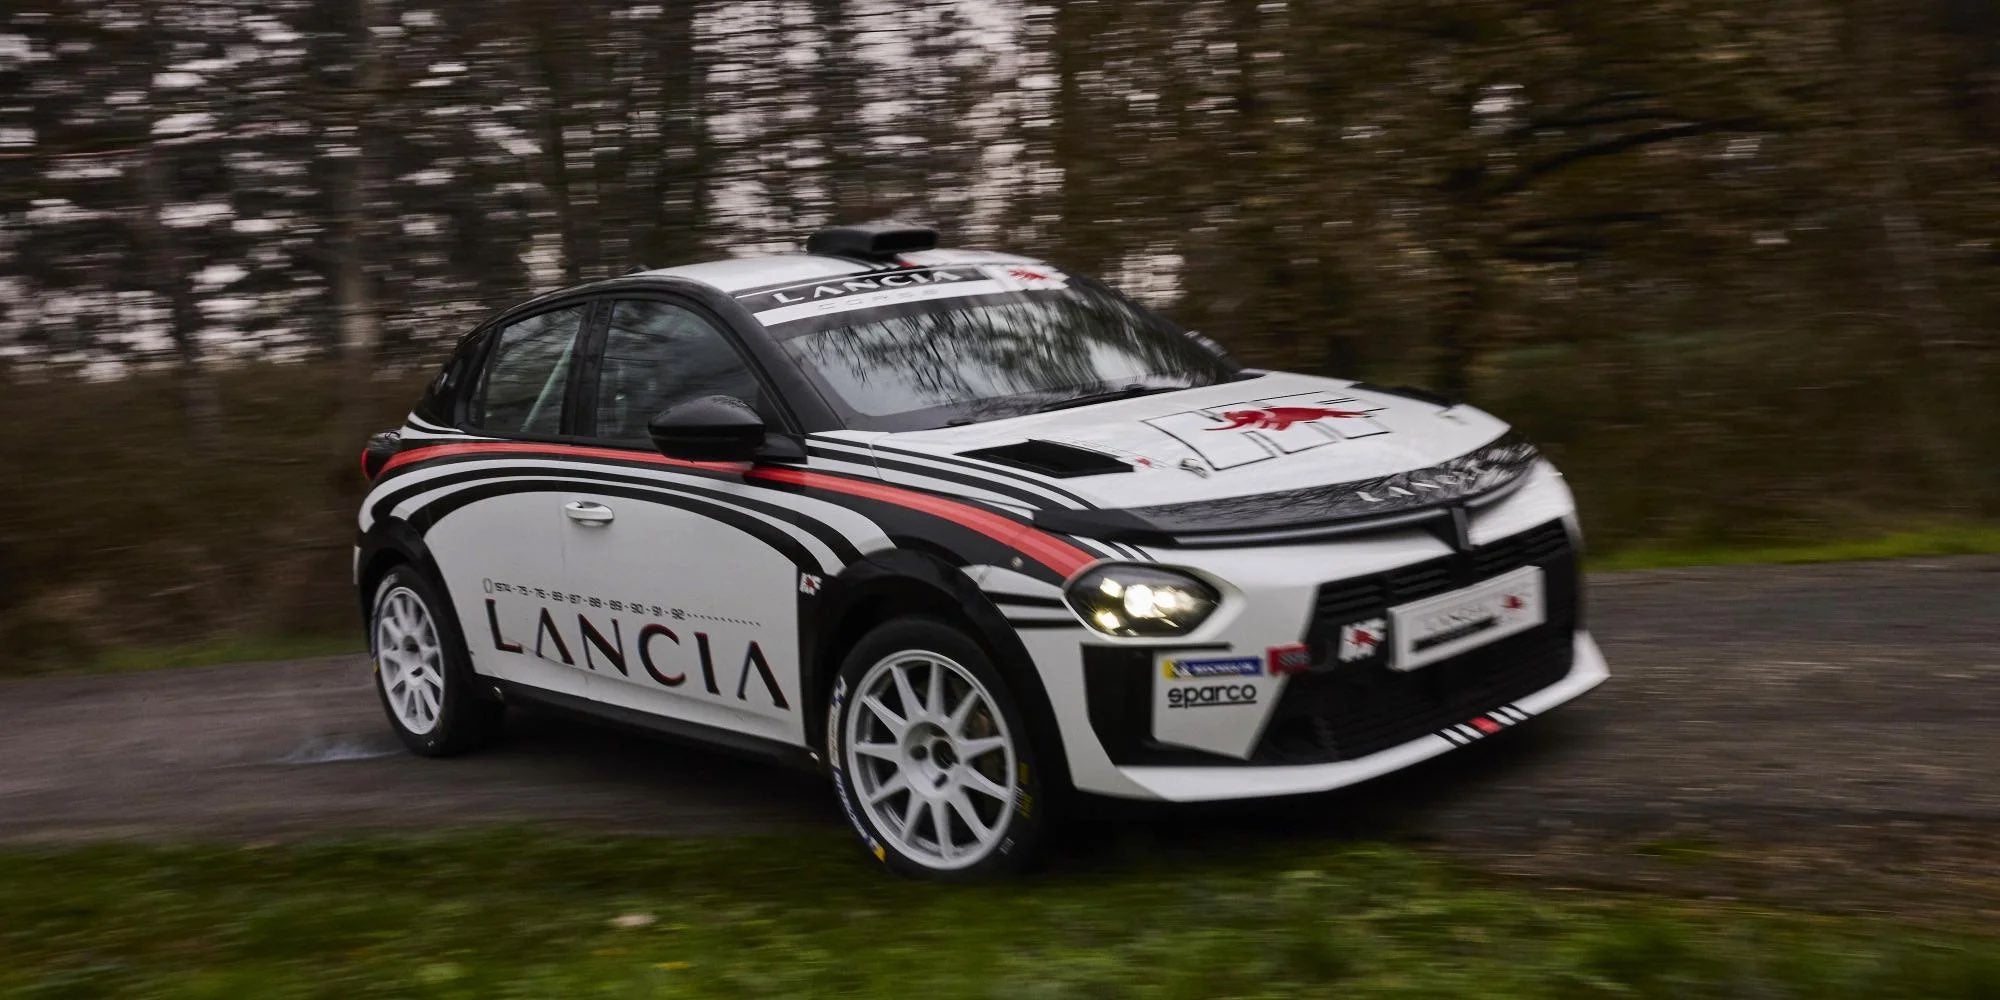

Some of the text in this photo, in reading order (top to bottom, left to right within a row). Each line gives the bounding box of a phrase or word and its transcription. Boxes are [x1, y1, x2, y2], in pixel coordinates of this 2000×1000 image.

[772, 270, 963, 304] LANCIA
[485, 599, 791, 712] LANCIA
[1167, 684, 1257, 709] sparco
